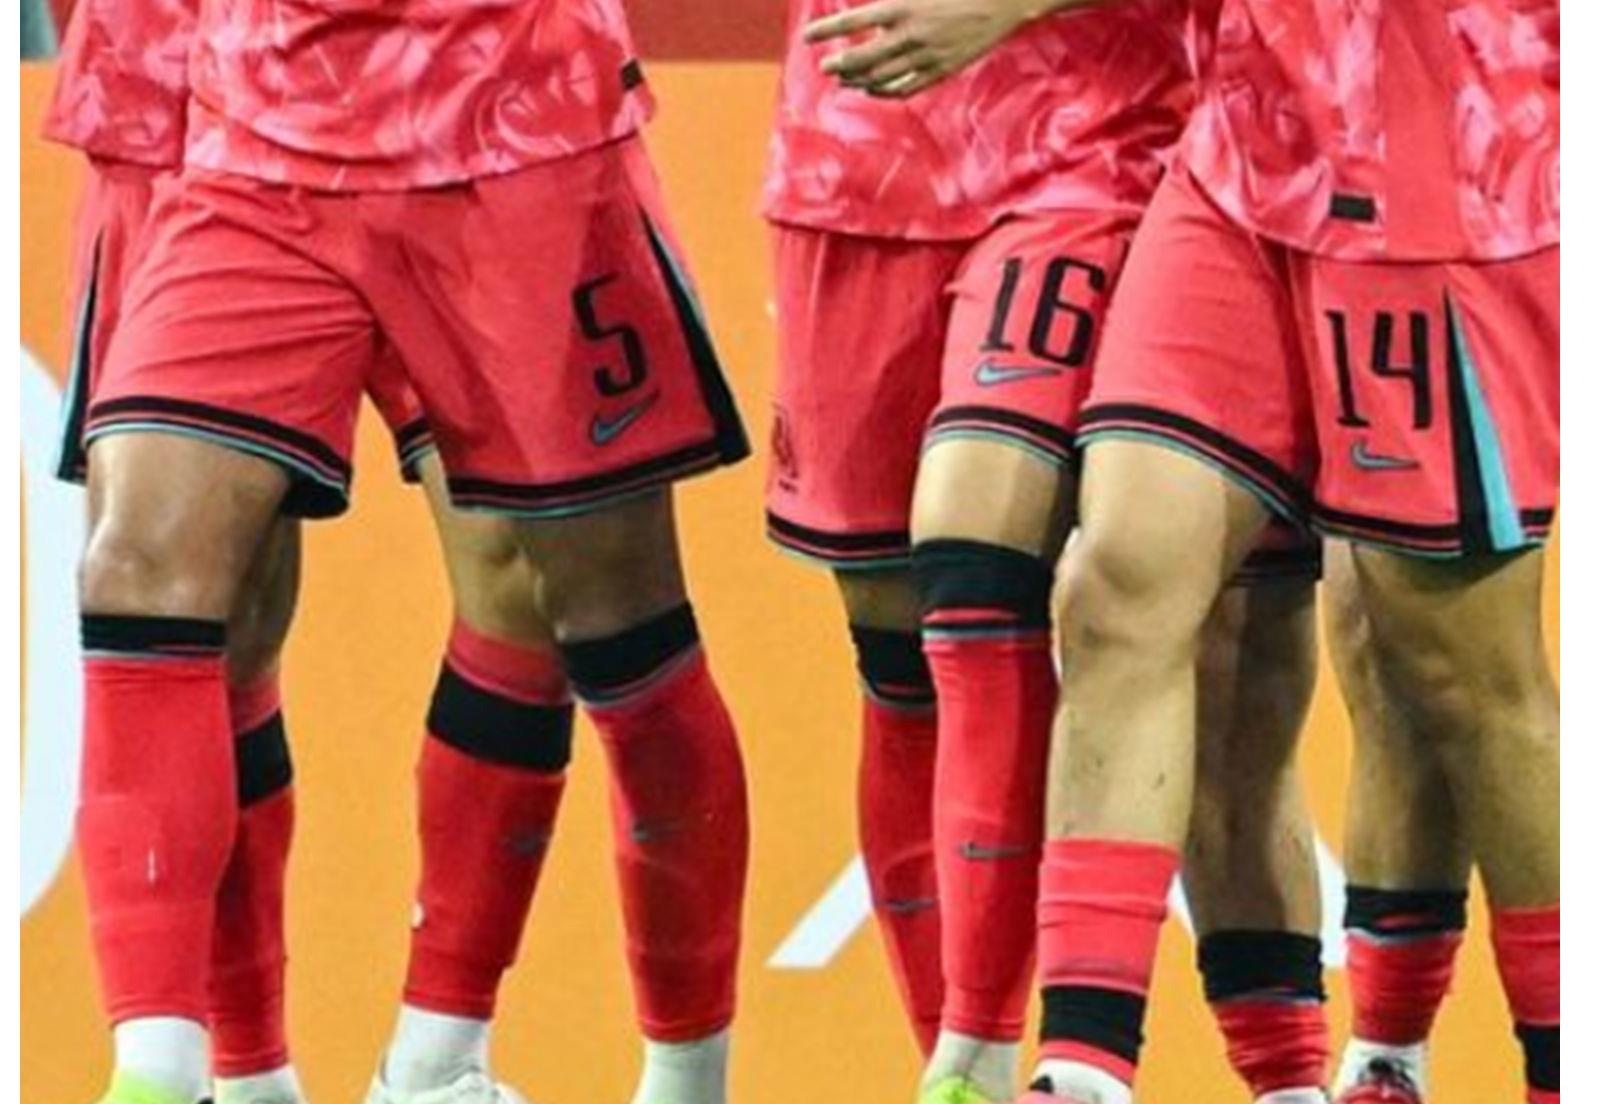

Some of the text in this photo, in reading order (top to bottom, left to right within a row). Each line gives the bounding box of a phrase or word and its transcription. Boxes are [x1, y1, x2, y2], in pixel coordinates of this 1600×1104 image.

[572, 275, 649, 398] 5
[977, 256, 1107, 367] 16
[1325, 309, 1434, 431] 14
